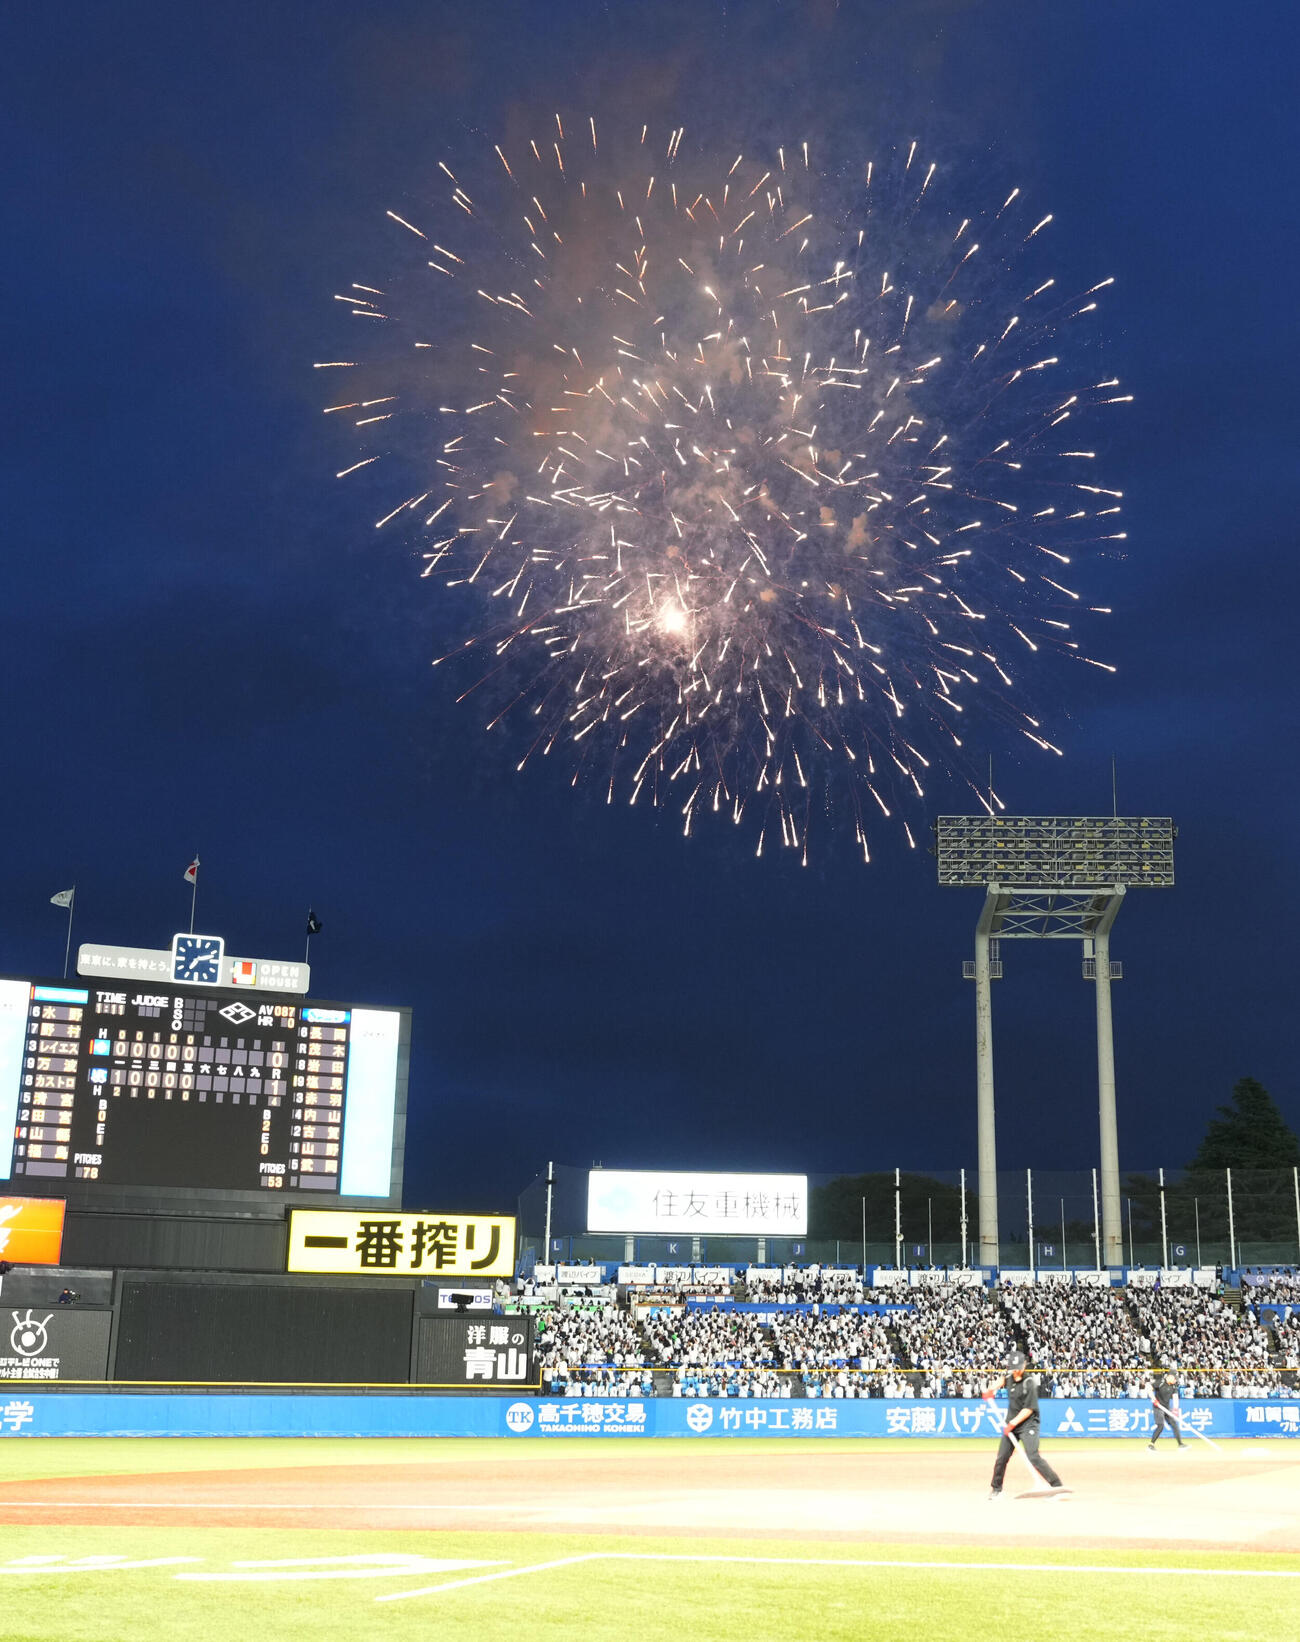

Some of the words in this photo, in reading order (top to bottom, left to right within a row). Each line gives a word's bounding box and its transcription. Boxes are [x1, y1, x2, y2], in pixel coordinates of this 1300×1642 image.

[261, 964, 299, 977] OPEN
[260, 977, 298, 988] HOUSE
[96, 992, 127, 1004] TIME
[131, 995, 169, 1007] JUDGE
[174, 998, 183, 1008] B
[32, 1006, 40, 1017] 6
[96, 1003, 124, 1015] 1:11
[173, 1009, 183, 1019] S
[259, 1005, 274, 1015] AV
[172, 1020, 182, 1030] O
[258, 1016, 273, 1026] HR
[288, 1018, 295, 1028] 0
[31, 1023, 38, 1034] 7
[29, 1040, 36, 1051] 3
[40, 1041, 78, 1055] レイエス
[116, 1042, 125, 1055] 0
[133, 1043, 142, 1056] 0
[151, 1045, 160, 1058] 0
[168, 1046, 177, 1059] 0
[185, 1047, 194, 1060] 0
[273, 1053, 282, 1067] 0
[131, 1060, 142, 1068] 二
[149, 1061, 159, 1070] 三
[200, 1064, 210, 1074] 六
[217, 1065, 227, 1075] 七
[233, 1066, 243, 1076] 八
[250, 1067, 260, 1077] 九
[272, 1069, 281, 1079] R
[25, 1075, 33, 1086] 8
[35, 1075, 76, 1089] カストロ
[115, 1070, 120, 1083] 1
[131, 1071, 140, 1085] 0
[148, 1072, 157, 1086] 0
[165, 1073, 174, 1087] 0
[182, 1075, 191, 1088] 0
[272, 1080, 278, 1095] 1
[23, 1092, 31, 1103] 5
[296, 1093, 303, 1103] 3
[99, 1099, 107, 1110] B
[21, 1110, 29, 1121] 2
[98, 1111, 106, 1121] 0
[263, 1109, 271, 1120] B
[294, 1109, 302, 1120] 4
[97, 1123, 105, 1134] E
[262, 1121, 270, 1131] 2
[293, 1126, 301, 1136] 2
[19, 1127, 27, 1138] 4
[261, 1133, 270, 1143] E
[98, 1135, 102, 1145] 1
[18, 1145, 24, 1156] 1
[261, 1144, 268, 1154] 0
[294, 1143, 298, 1153] 1
[74, 1153, 102, 1165] PITCHES
[292, 1159, 298, 1170] 5
[260, 1163, 285, 1174] PITCHES
[268, 1176, 282, 1187] 53
[652, 1188, 801, 1219] 住友重機械
[304, 1220, 501, 1269] 一番搾り
[554, 1240, 560, 1251] L
[669, 1243, 677, 1254] K
[795, 1244, 801, 1255] J
[1044, 1246, 1053, 1256] H
[1175, 1245, 1185, 1256] G
[467, 1325, 525, 1345] 洋服の
[463, 1346, 527, 1379] 青山
[1012, 1355, 1019, 1365] J
[0, 1401, 34, 1431] 学
[507, 1410, 534, 1424] TK
[538, 1403, 647, 1424] 高千穂交易
[719, 1406, 838, 1431] 竹中工務店
[540, 1424, 601, 1433] TAKACHIHO
[603, 1424, 646, 1433] KOHEKI
